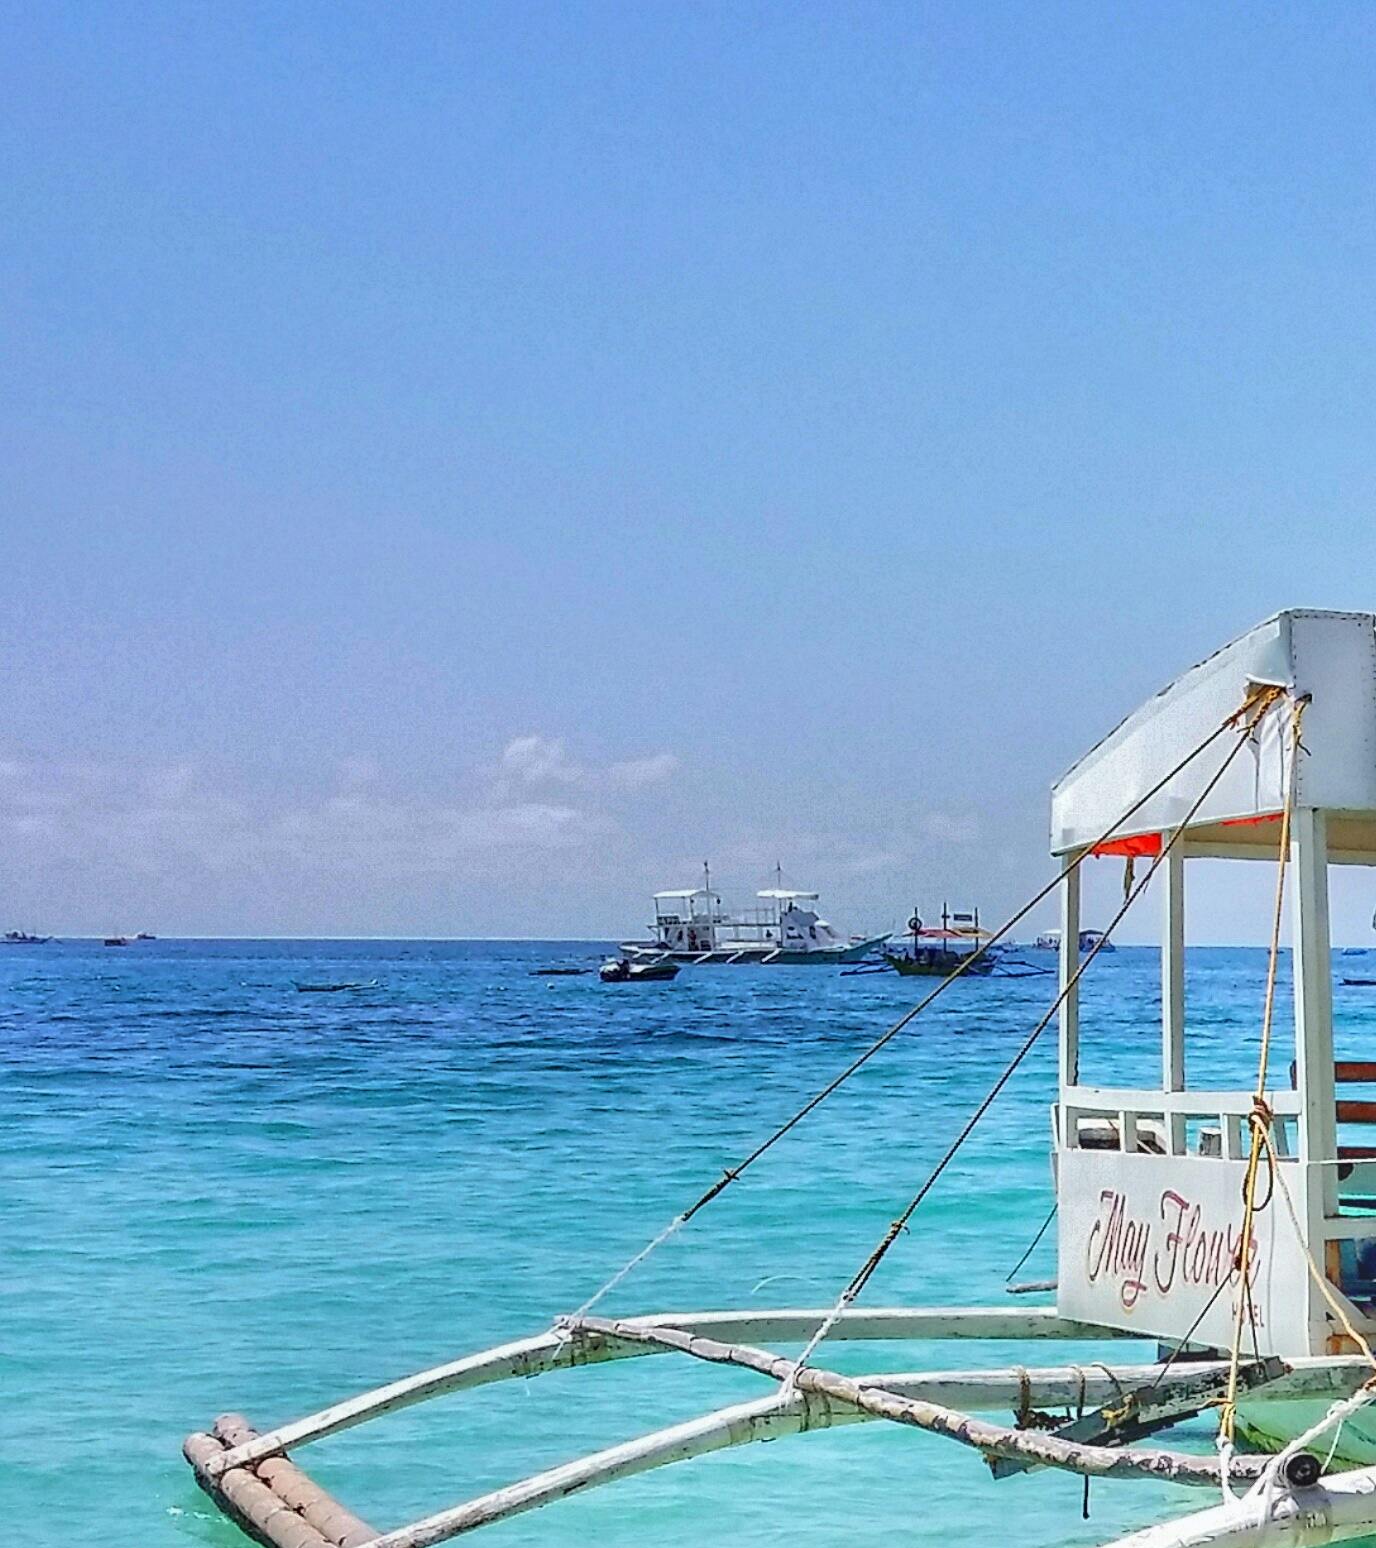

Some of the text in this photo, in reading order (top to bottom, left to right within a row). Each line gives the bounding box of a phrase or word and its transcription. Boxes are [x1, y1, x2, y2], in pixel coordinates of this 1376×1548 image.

[1088, 1189, 1261, 1307] May Flow
[1231, 1301, 1265, 1328] HTEL
